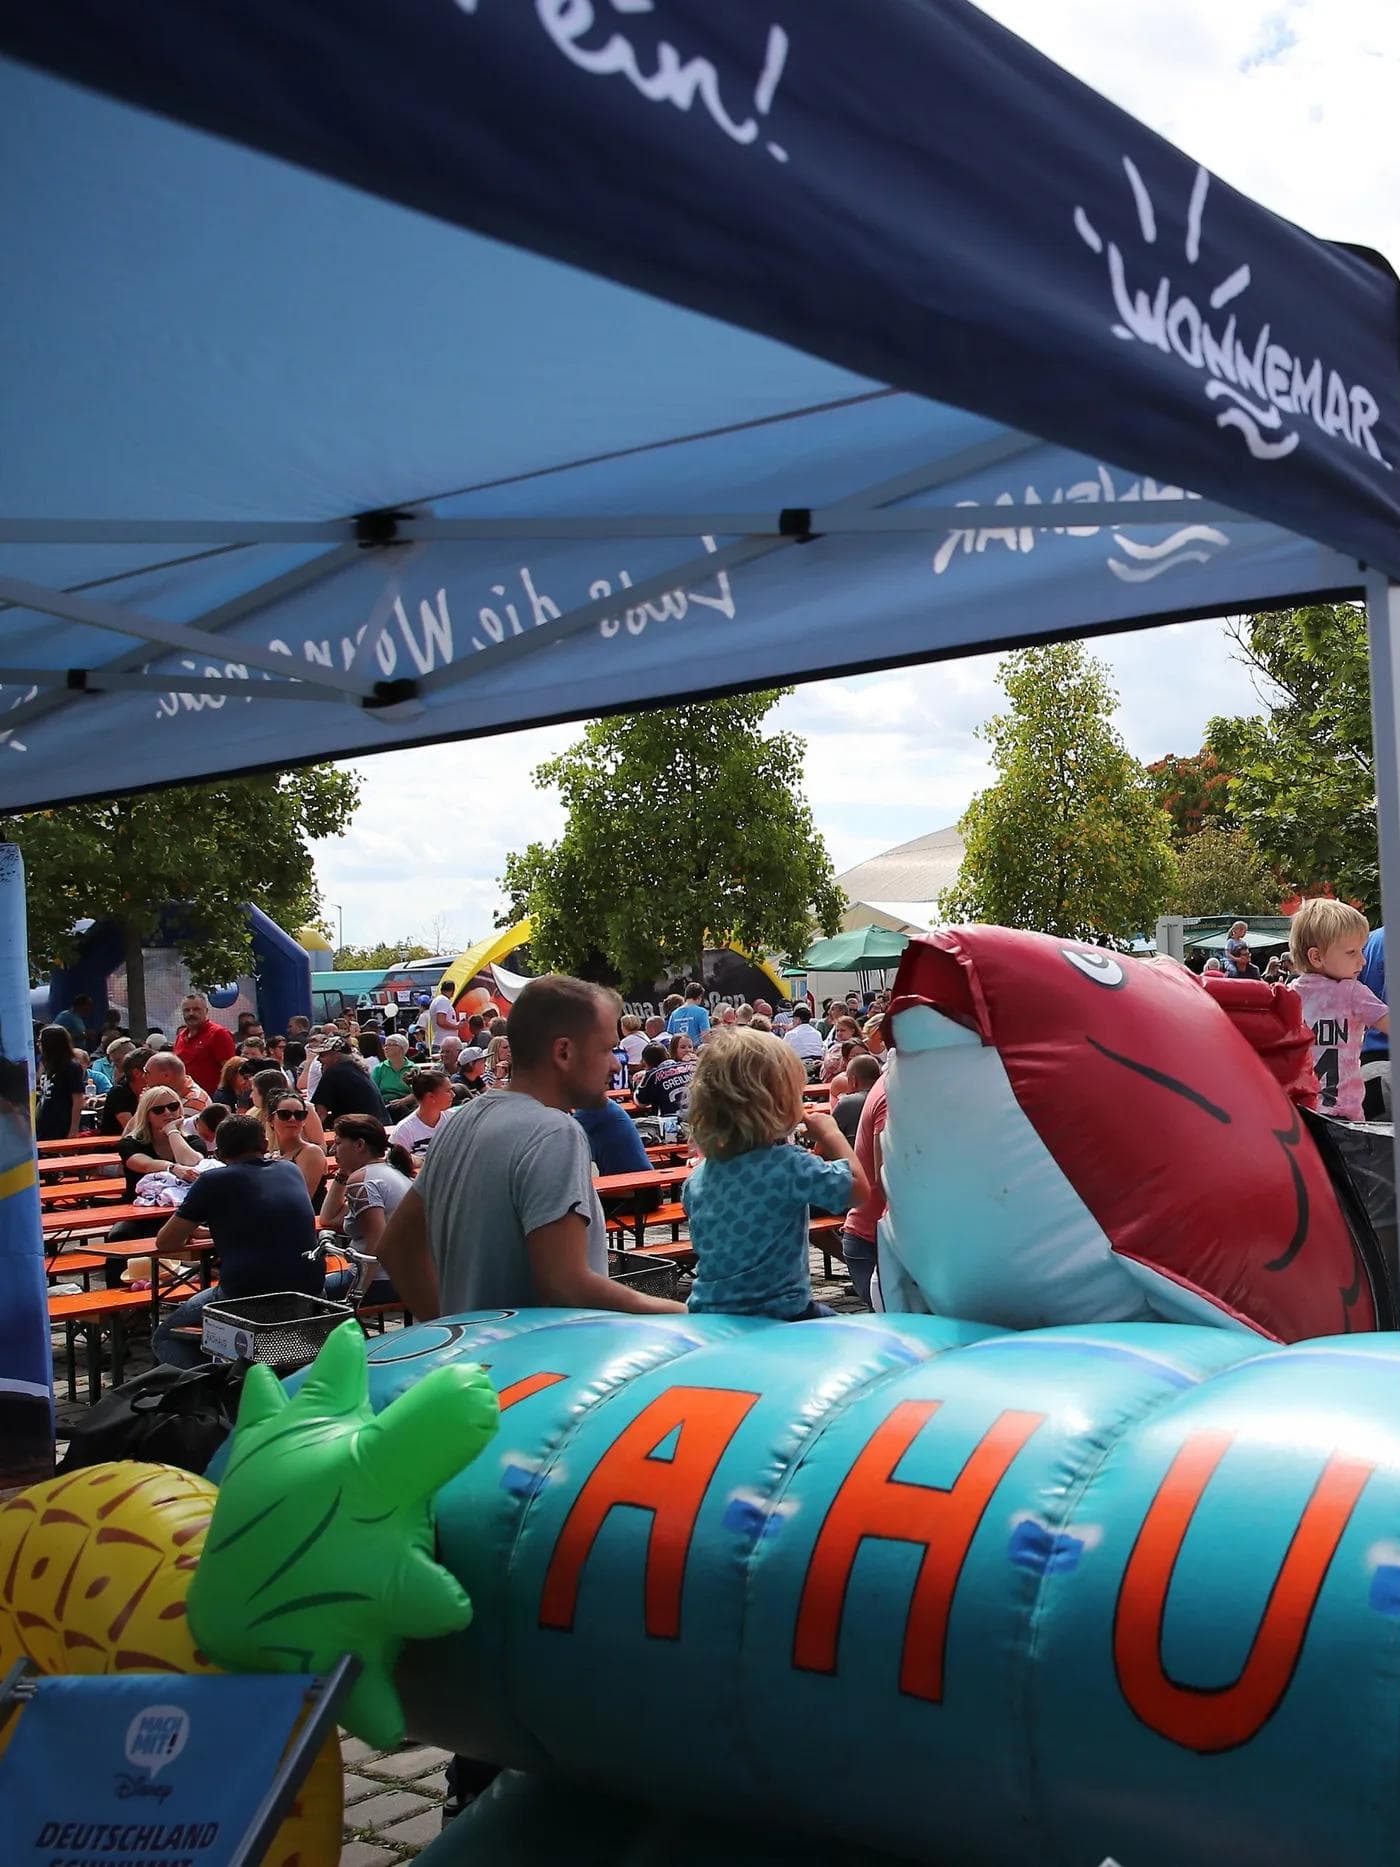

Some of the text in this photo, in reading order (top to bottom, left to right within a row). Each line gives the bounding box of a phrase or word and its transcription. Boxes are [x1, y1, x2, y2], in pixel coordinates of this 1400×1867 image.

[1109, 242, 1394, 471] WONNEMAR
[140, 1716, 184, 1733] MACH
[130, 1732, 179, 1756] MIT!
[112, 1772, 175, 1806] Disney
[34, 1821, 220, 1852] DEUTSCHLAND
